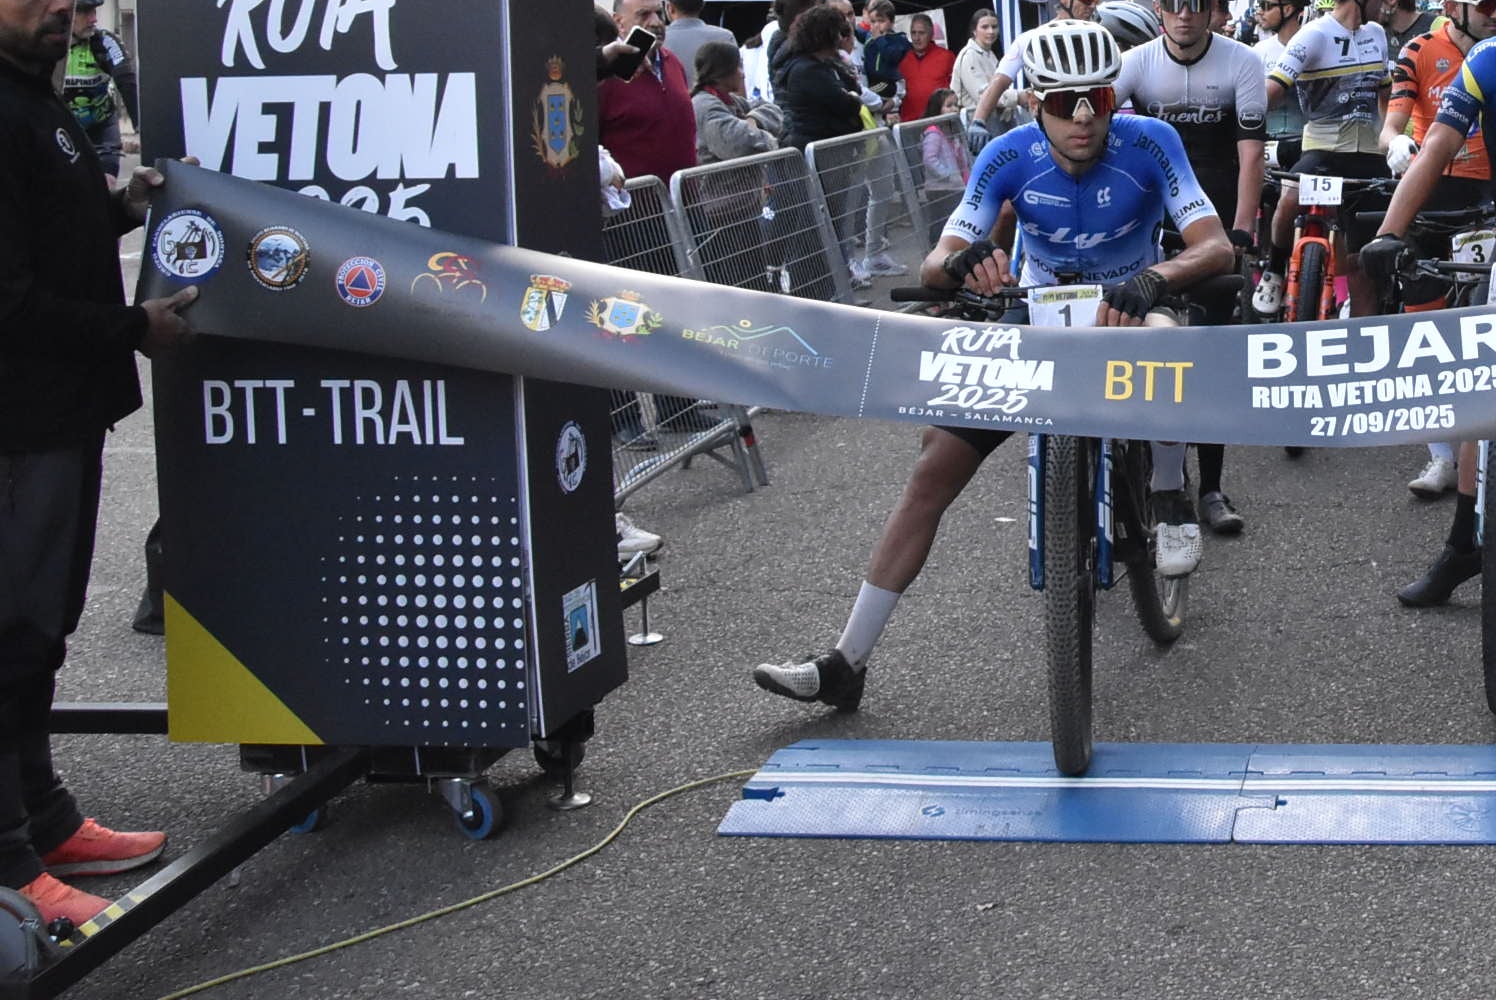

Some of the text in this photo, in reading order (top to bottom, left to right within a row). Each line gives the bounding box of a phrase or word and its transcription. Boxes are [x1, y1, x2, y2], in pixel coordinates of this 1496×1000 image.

[179, 71, 480, 181] VETONA
[966, 148, 1019, 212] Jarmauto
[1133, 131, 1180, 198] Jarmauto
[1311, 177, 1332, 192] 15
[1470, 243, 1485, 263] 3
[1058, 304, 1072, 327] 1
[749, 343, 834, 369] DEPORTE
[941, 326, 1023, 360] RUTA
[918, 349, 1055, 392] VETONA
[1103, 360, 1194, 403] BTT
[926, 385, 1029, 415] 2025
[1251, 384, 1324, 410] RUTA
[1327, 375, 1433, 407] VETONA
[202, 379, 465, 446] BTT-TRAIL
[964, 411, 1054, 427] SALAMANCA
[1310, 404, 1456, 437] 27 /09/2025
